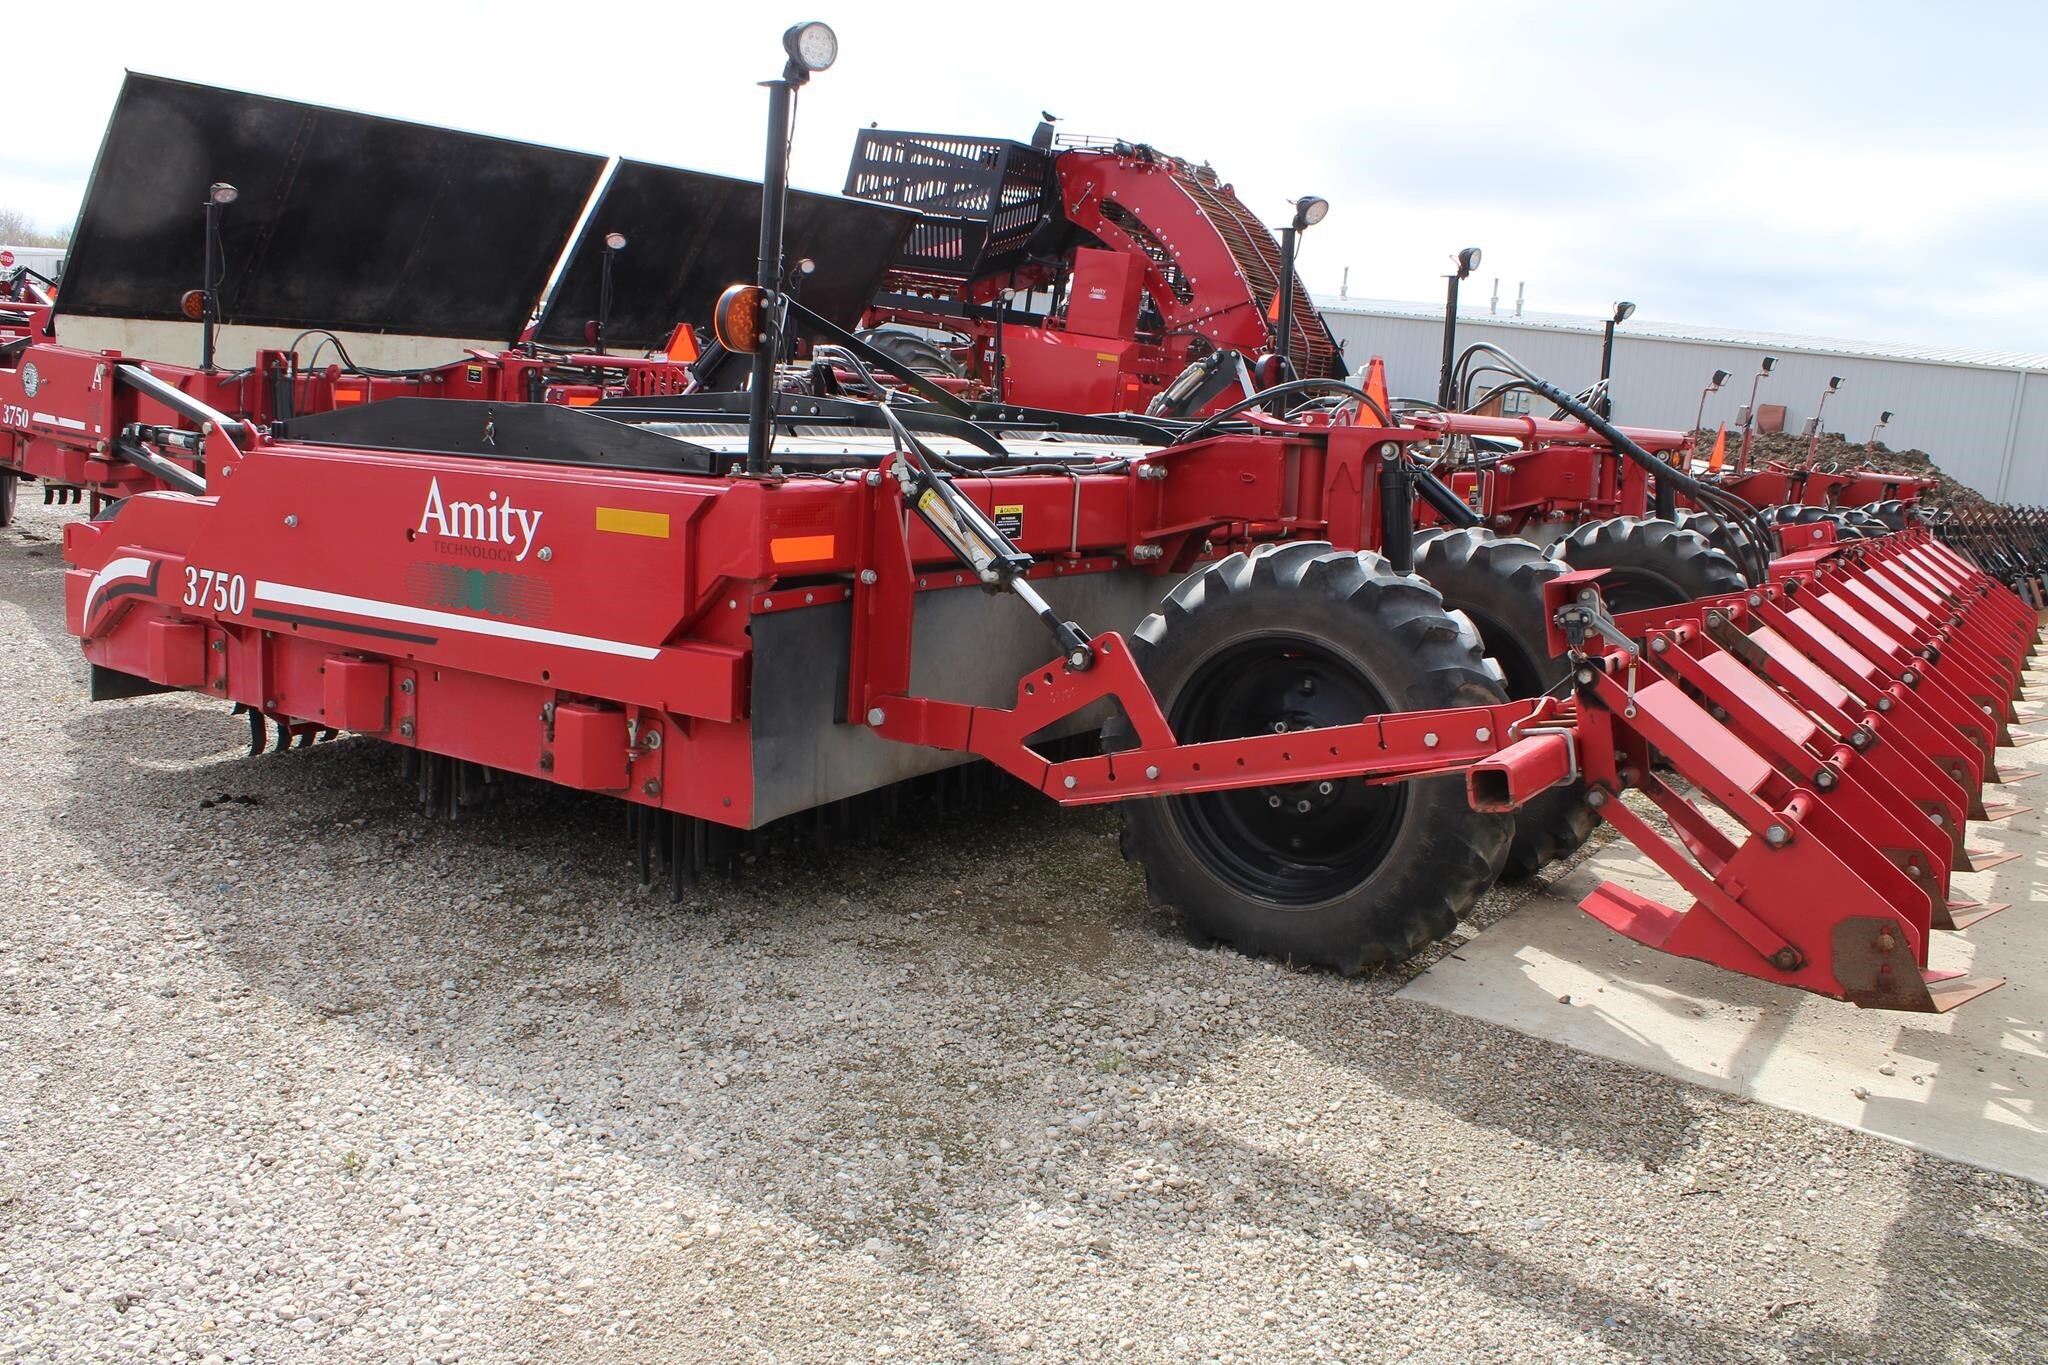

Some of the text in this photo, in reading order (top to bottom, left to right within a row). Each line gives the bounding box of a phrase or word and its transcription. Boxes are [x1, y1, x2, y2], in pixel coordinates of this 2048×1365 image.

[3, 404, 29, 428] 3750
[417, 475, 543, 562] Amity
[432, 540, 515, 562] TECHNOLOGY
[183, 565, 246, 615] 3750
